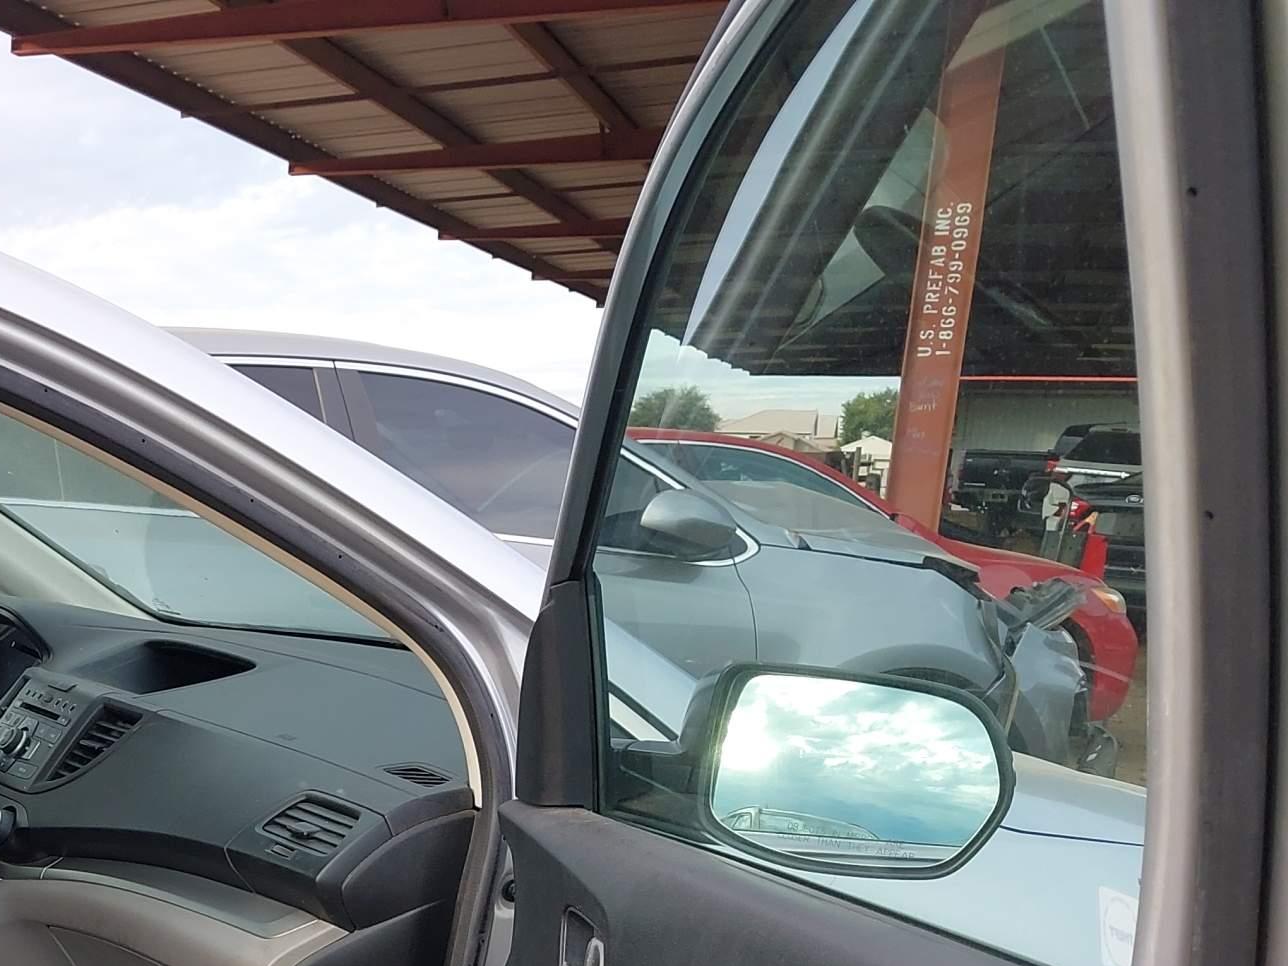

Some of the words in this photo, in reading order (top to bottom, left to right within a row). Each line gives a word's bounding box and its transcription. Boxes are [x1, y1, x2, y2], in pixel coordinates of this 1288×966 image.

[935, 202, 954, 236] INC.
[923, 244, 947, 314] PREFAB
[935, 202, 973, 356] 1-866-799-0969
[917, 325, 936, 357] U.S.
